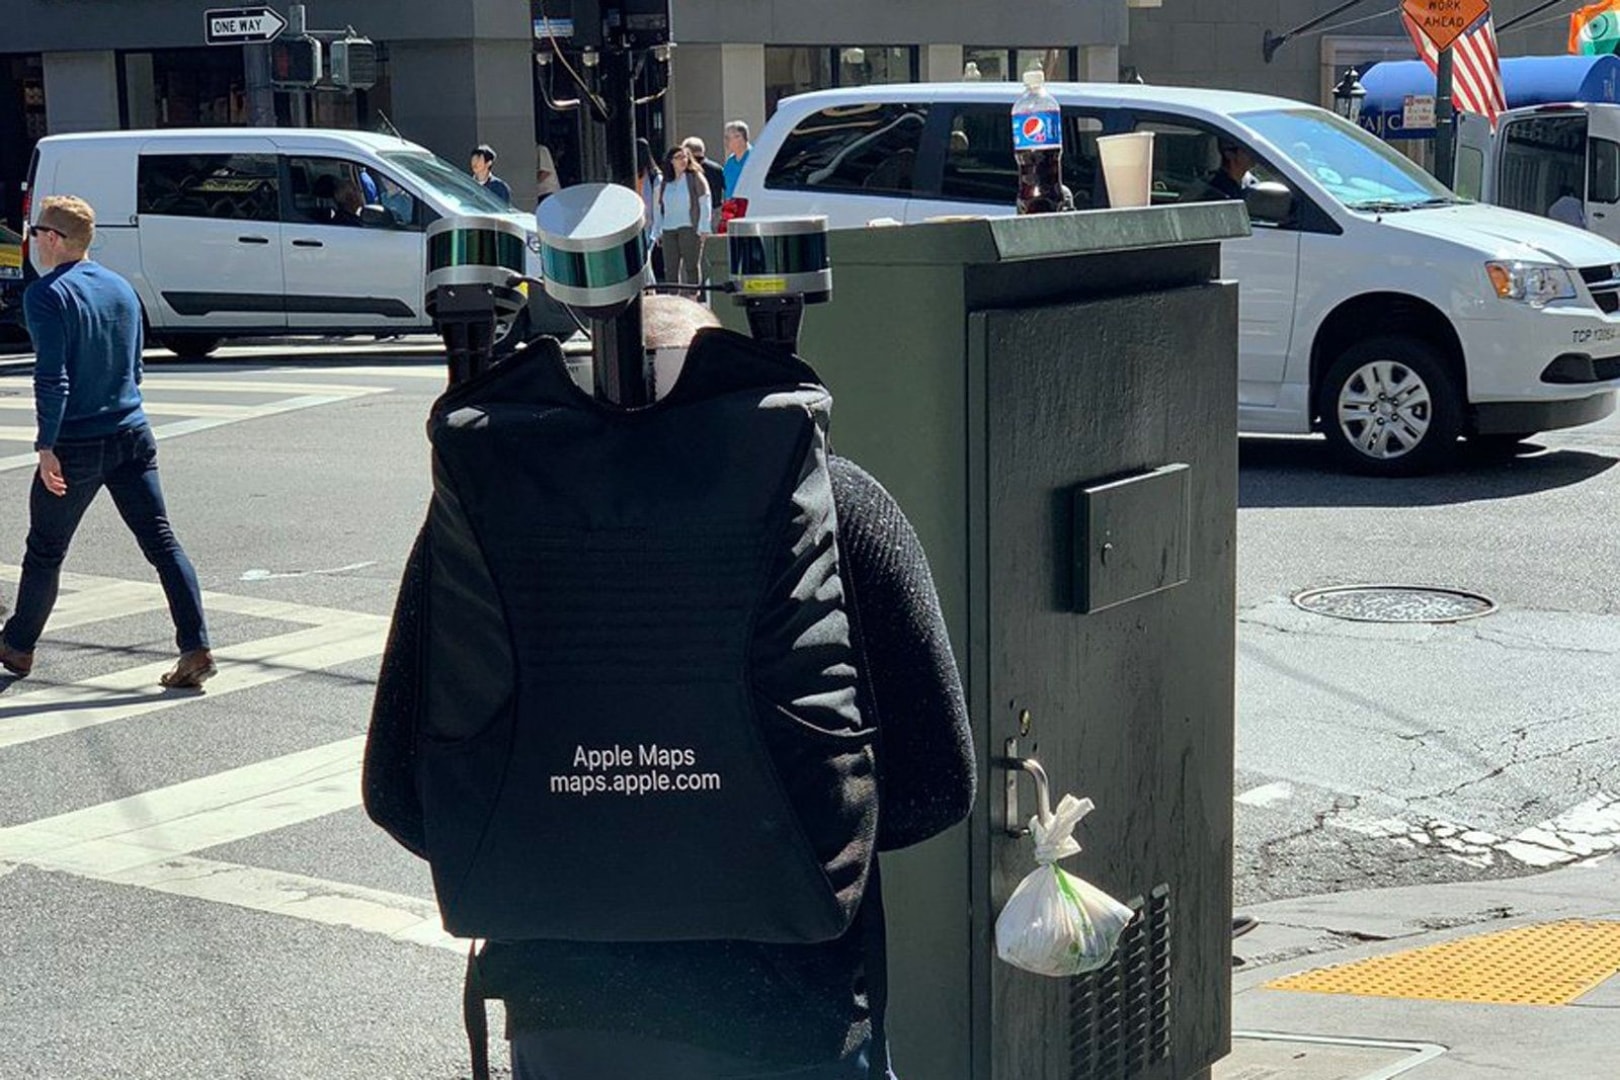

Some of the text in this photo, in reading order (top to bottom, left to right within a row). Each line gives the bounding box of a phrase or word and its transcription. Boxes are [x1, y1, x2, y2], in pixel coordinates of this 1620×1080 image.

[1428, 0, 1461, 11] WORK
[214, 19, 262, 33] ONE WAY
[1424, 16, 1464, 27] AHEAD
[1572, 328, 1591, 342] TCP
[573, 744, 695, 771] Apple Maps
[550, 770, 721, 796] maps.apple.com
